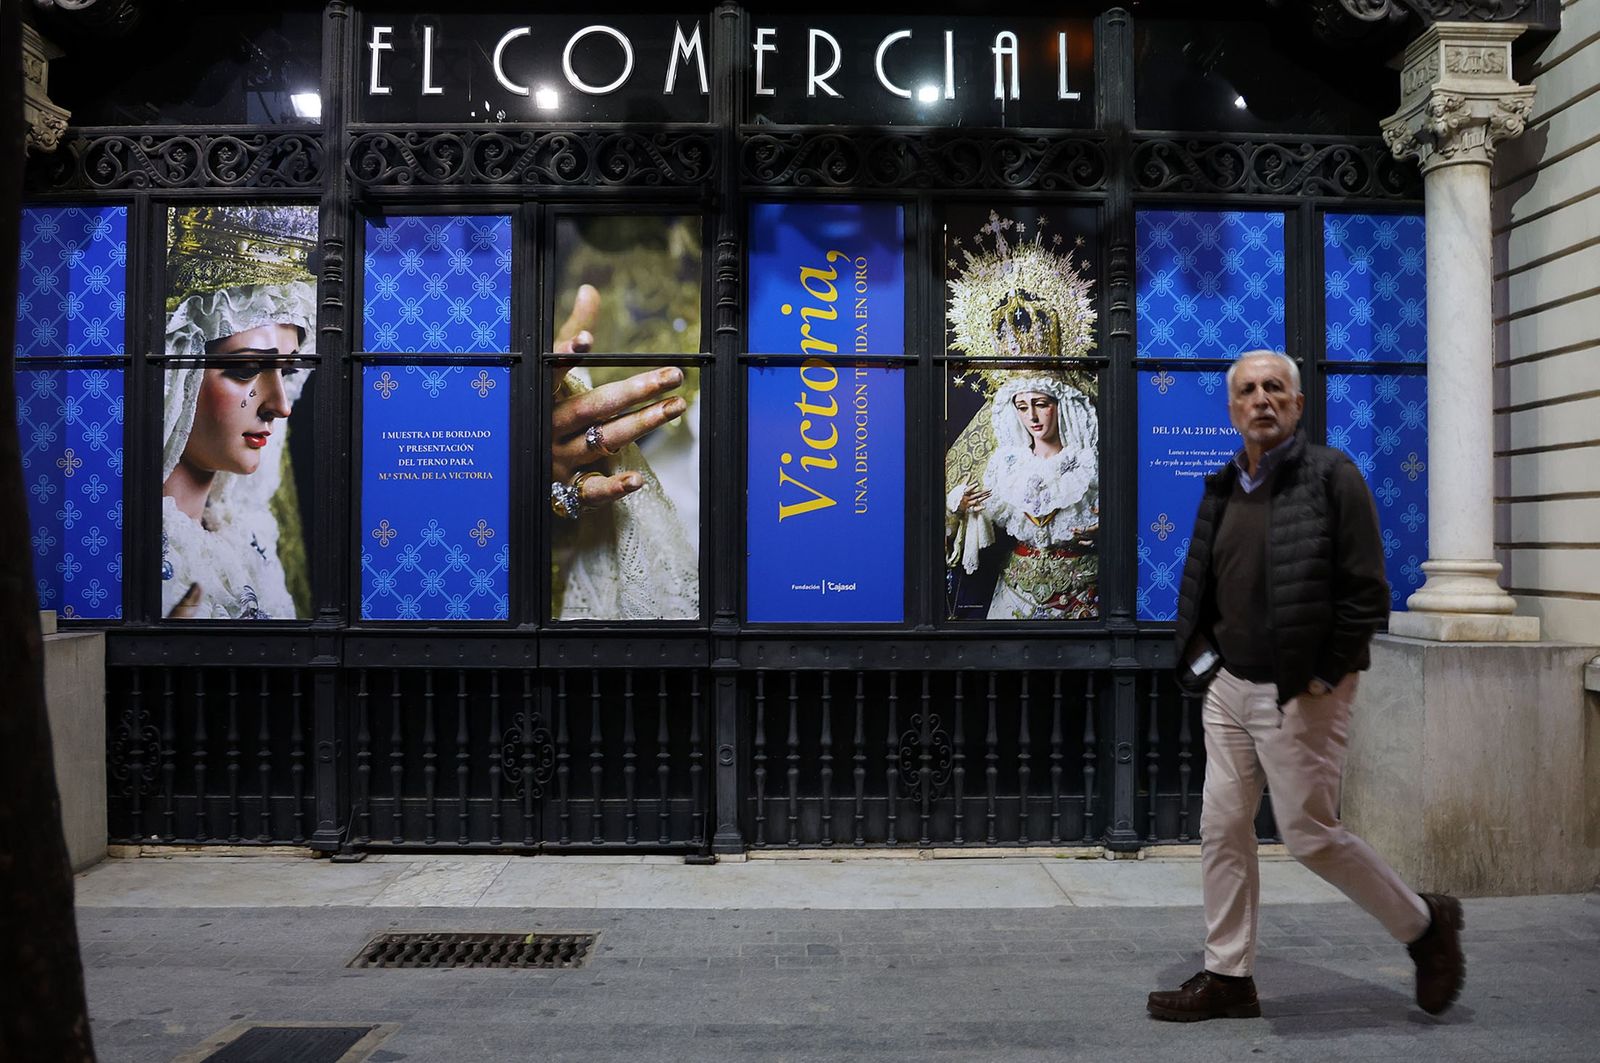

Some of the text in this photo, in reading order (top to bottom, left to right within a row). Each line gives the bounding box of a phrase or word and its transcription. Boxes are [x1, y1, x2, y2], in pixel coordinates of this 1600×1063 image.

[368, 20, 1081, 101] EL COMERCIAL
[779, 250, 851, 523] Victoria,
[852, 256, 869, 514] UNA DEVOCIÓN TEIDA EN ORO
[382, 430, 491, 439] I MUESTRA DE BORDADO
[1152, 426, 1242, 436] DEL 13 AL 23 DE NOV
[399, 443, 474, 452] Y PRESENTACIÓN
[398, 458, 474, 466] DEL TERNO PARA
[393, 472, 420, 480] STMA.
[422, 472, 433, 480] DE
[435, 472, 447, 480] LA
[449, 471, 493, 480] VICTORIA
